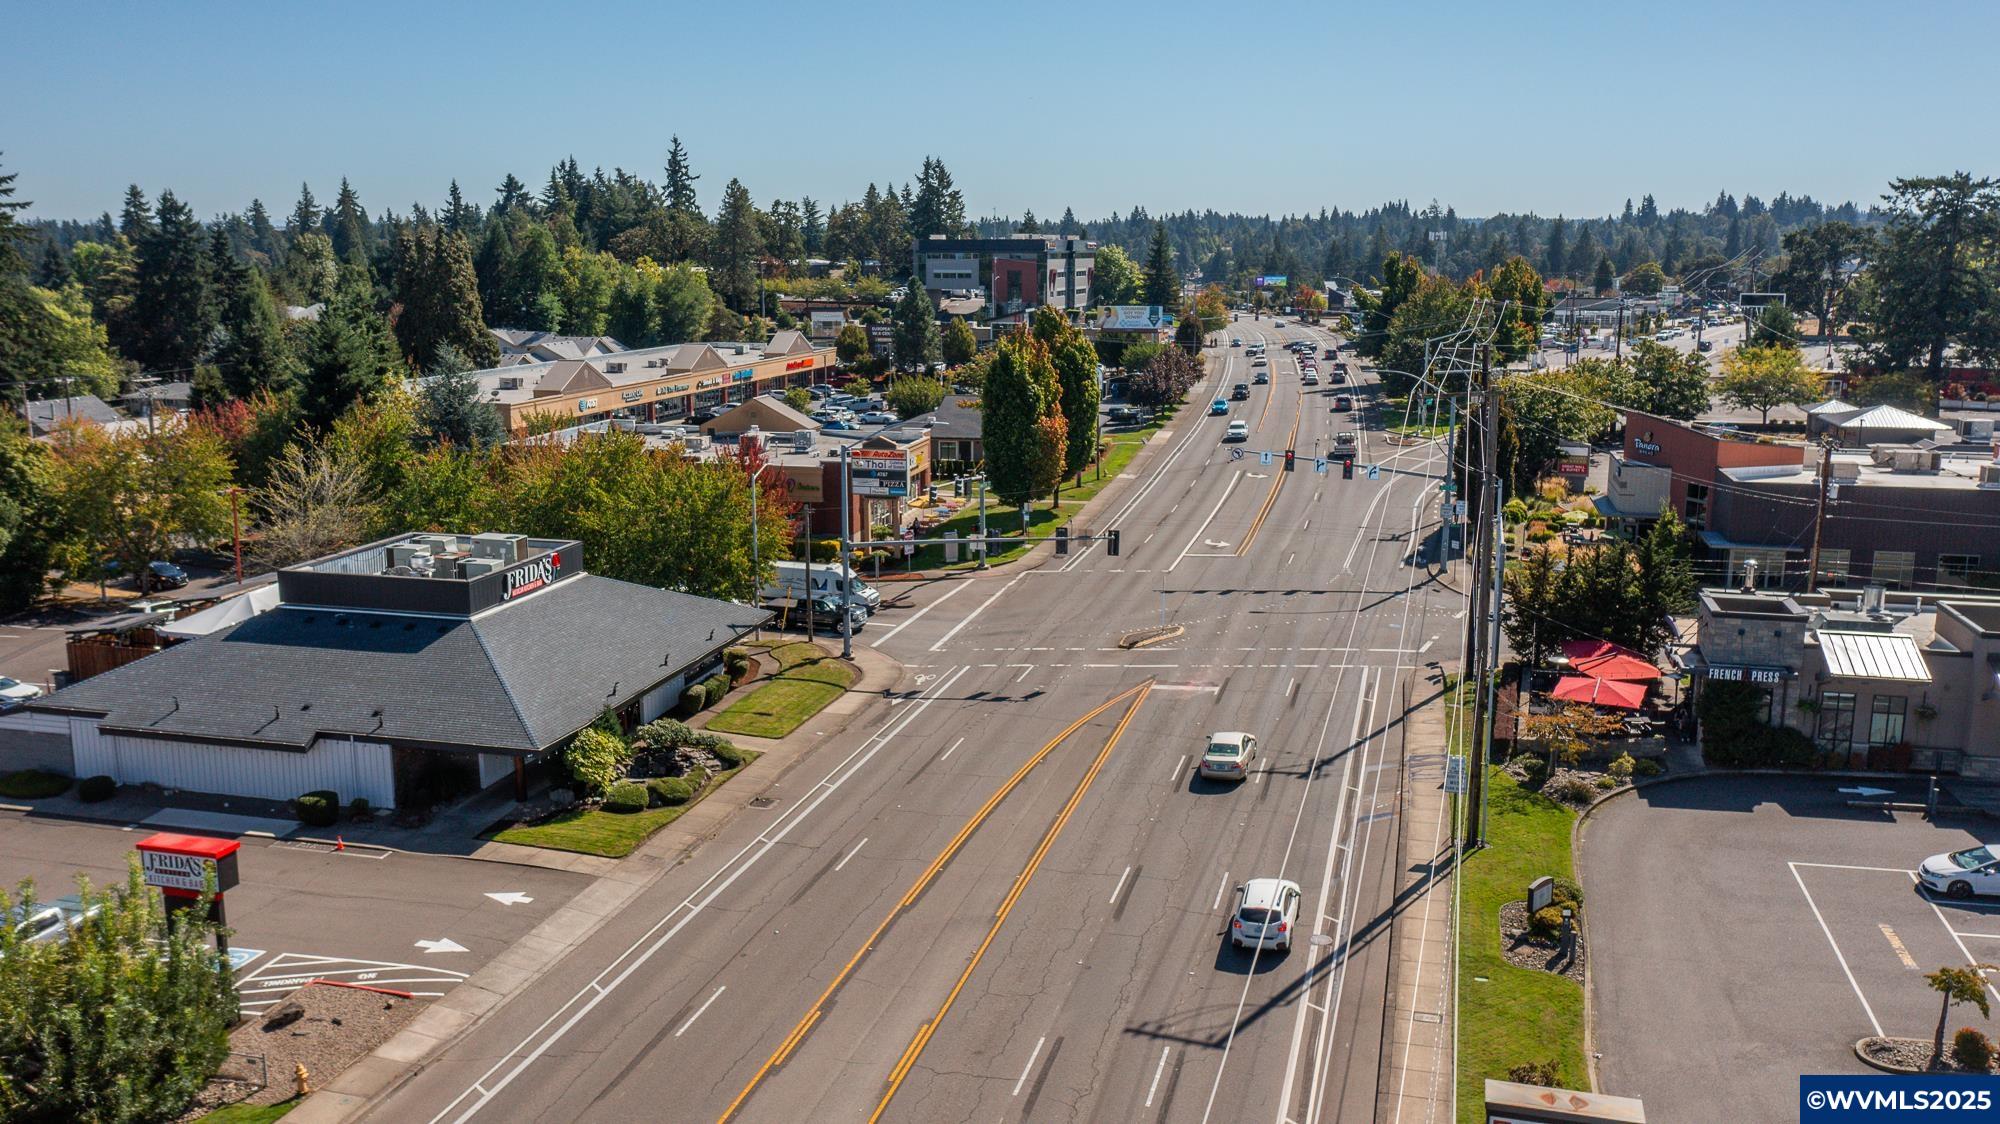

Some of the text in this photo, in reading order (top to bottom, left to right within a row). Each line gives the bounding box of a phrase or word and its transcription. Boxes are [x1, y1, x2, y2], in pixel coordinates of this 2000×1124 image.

[1634, 438, 1660, 451] Panera
[865, 460, 887, 469] Thai
[503, 557, 552, 600] FRIDA'S
[1708, 668, 1780, 683] FRENCH PRESS
[146, 853, 202, 877] FRIDA'S
